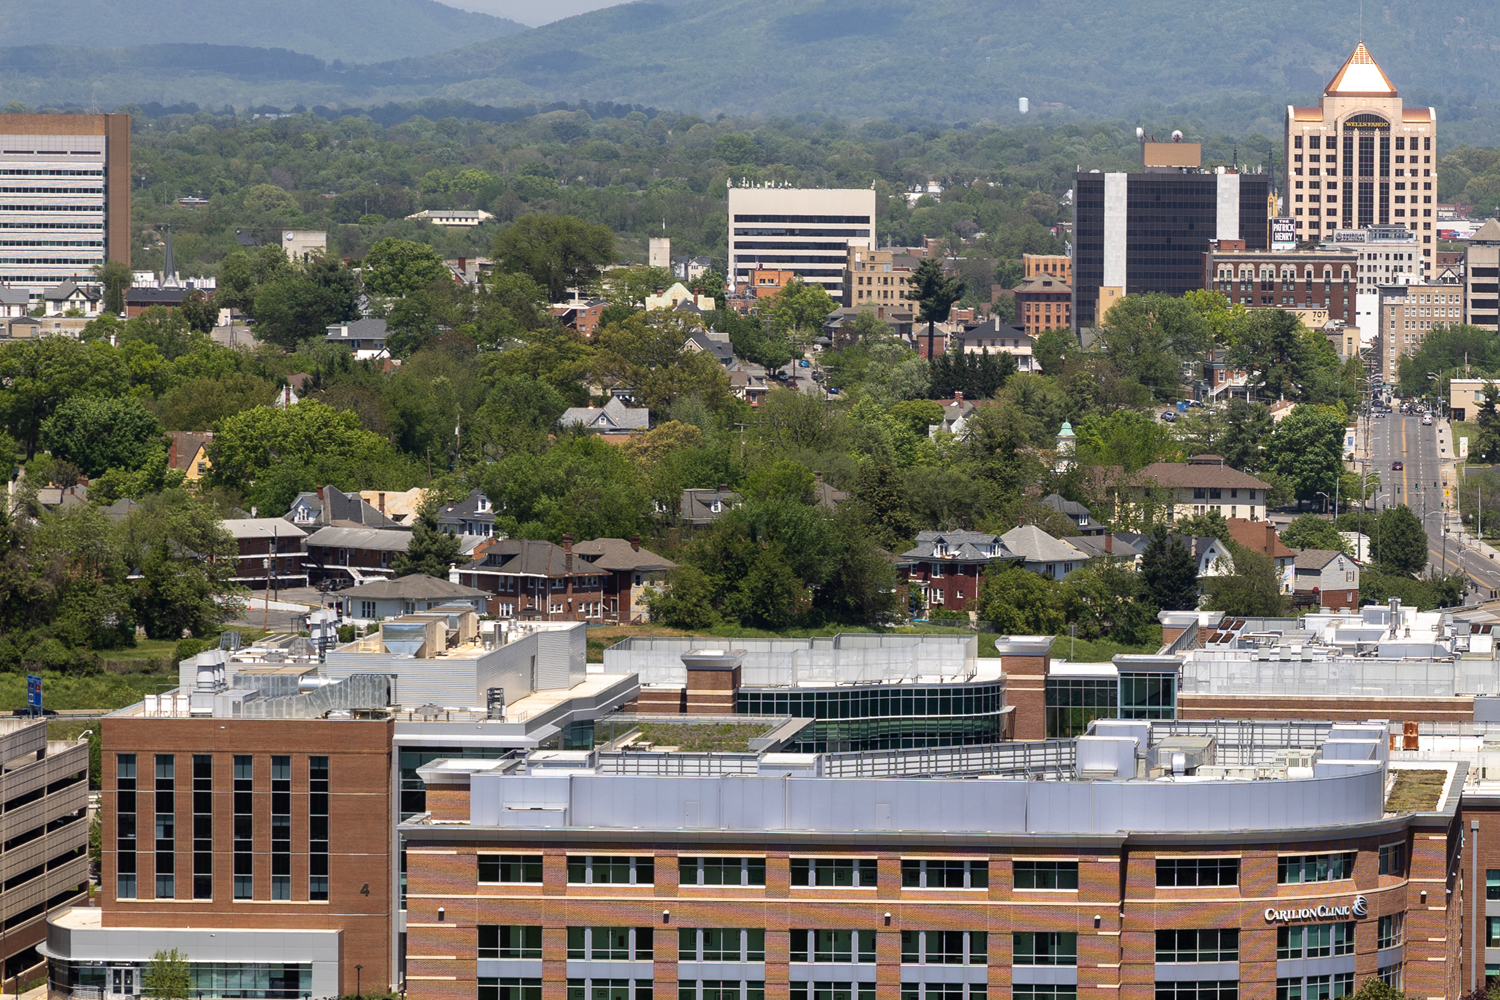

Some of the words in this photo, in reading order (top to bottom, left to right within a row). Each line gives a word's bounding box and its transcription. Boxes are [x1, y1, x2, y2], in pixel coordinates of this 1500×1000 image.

[1274, 232, 1293, 241] HENRY
[360, 883, 370, 897] 4
[1264, 908, 1317, 921] CARILION
[1317, 905, 1350, 917] CLINIC
